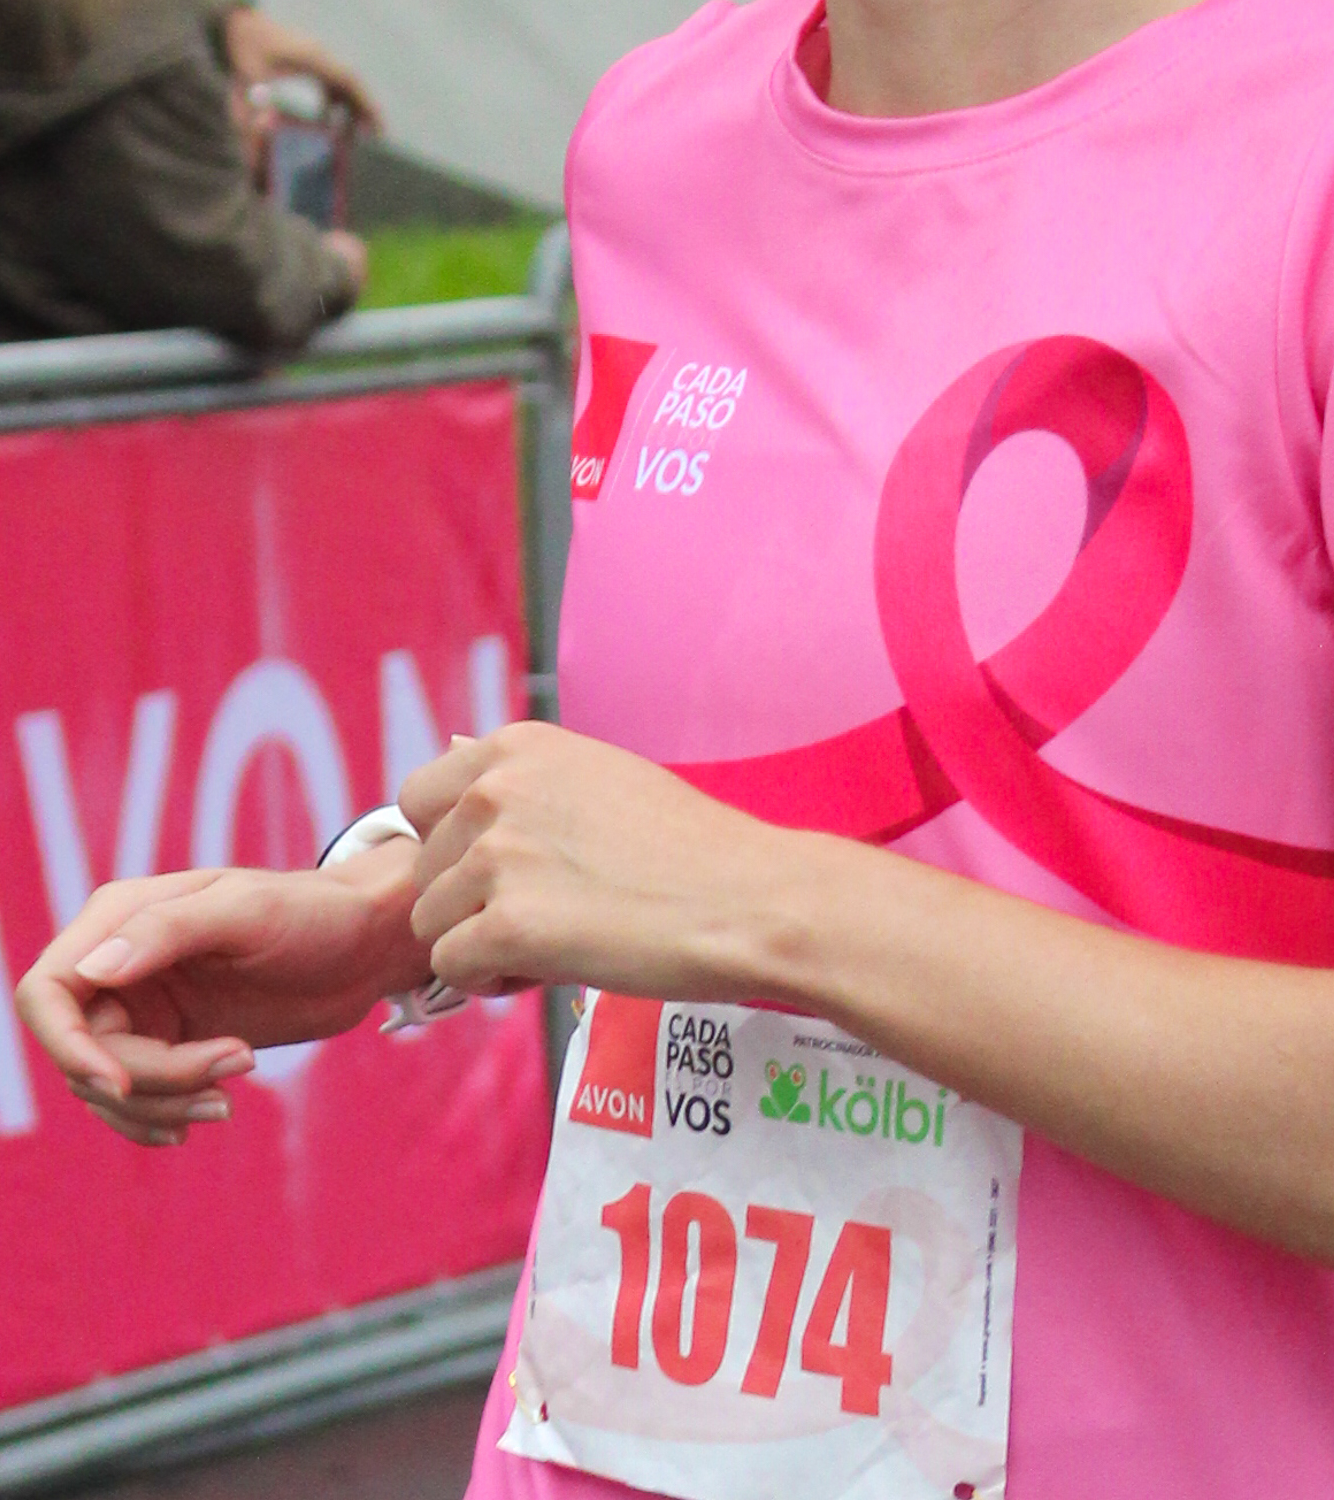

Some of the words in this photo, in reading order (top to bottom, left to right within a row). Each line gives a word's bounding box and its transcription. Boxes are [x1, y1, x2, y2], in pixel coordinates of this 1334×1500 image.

[673, 362, 748, 398] CADA
[653, 391, 736, 431] PASO
[634, 446, 711, 495] VOS
[669, 1013, 730, 1049] CADA
[667, 1041, 733, 1079] PASO
[577, 1083, 645, 1122] AVON
[666, 1090, 731, 1135] VOS
[819, 1068, 946, 1146] kölbi
[601, 1182, 892, 1417] 1074
